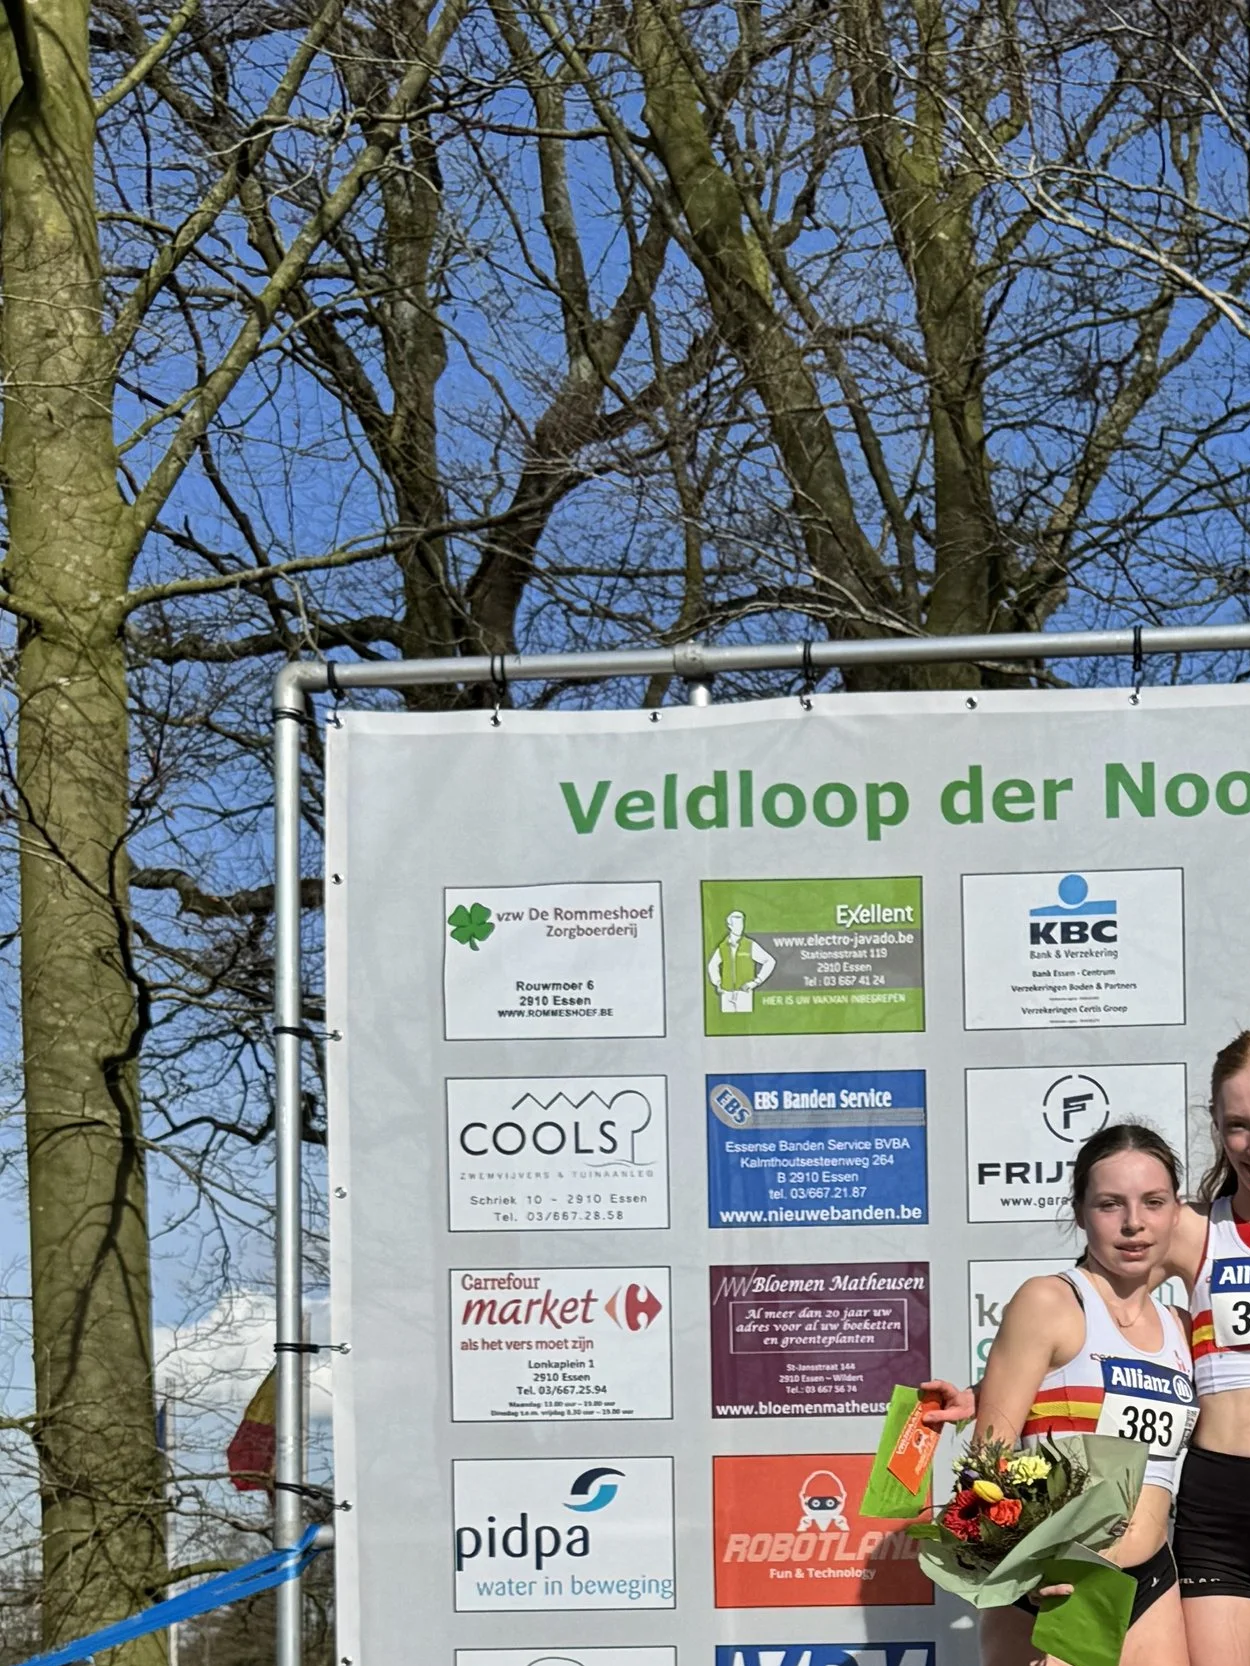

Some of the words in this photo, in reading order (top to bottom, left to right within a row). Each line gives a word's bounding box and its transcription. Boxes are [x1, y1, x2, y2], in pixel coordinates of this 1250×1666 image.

[559, 769, 910, 841] Veldloop
[940, 764, 1074, 825] der
[496, 911, 524, 922] vzw
[528, 908, 549, 921] De
[554, 905, 654, 920] Rommeshoef
[836, 904, 914, 927] Exellent
[546, 924, 638, 939] Zorgboerderij
[1029, 920, 1118, 945] KBC
[773, 933, 914, 948] www.electro-javado.be
[1029, 950, 1052, 960] Bank
[1054, 950, 1061, 959] &
[1064, 949, 1118, 960] Verzekering
[816, 963, 840, 972] 2910
[843, 963, 872, 972] Essen
[516, 981, 582, 992] Rouwmoer
[587, 980, 594, 990] 6
[519, 996, 549, 1006] 2910
[553, 996, 591, 1006] Essen
[716, 1089, 750, 1124] EBS
[754, 1091, 778, 1110] EBS
[783, 1090, 836, 1109] Banden
[840, 1088, 892, 1108] Service
[460, 1120, 618, 1156] COOLS
[725, 1141, 775, 1153] Essense
[779, 1140, 824, 1151] Banden
[828, 1139, 872, 1150] Service
[874, 1138, 910, 1149] BVBA
[740, 1156, 870, 1168] Kalmthoutsesteenweg
[872, 1155, 894, 1166] 264
[777, 1173, 786, 1183] B
[790, 1172, 819, 1182] 2910
[822, 1172, 859, 1182] Essen
[470, 1196, 517, 1205] Schriek
[527, 1195, 542, 1204] 10
[568, 1194, 602, 1204] 2910
[610, 1194, 647, 1204] Essen
[769, 1189, 787, 1200] tel.
[790, 1187, 866, 1199] 03/667.21.87
[720, 1204, 922, 1223] www.nieuwebanden.be
[461, 1272, 541, 1291] Carrefour
[752, 1274, 825, 1292] Bloemen
[829, 1273, 925, 1291] Matheusen
[462, 1288, 599, 1329] market
[461, 1339, 479, 1351] als
[481, 1338, 503, 1350] het
[506, 1340, 533, 1350] vers
[536, 1338, 569, 1349] moet
[763, 1337, 778, 1345] en
[781, 1332, 875, 1348] groenteplanten
[533, 1374, 559, 1382] 2910
[562, 1373, 591, 1381] Essen
[1111, 1366, 1172, 1394] Allianz
[517, 1387, 536, 1395] Tel.
[1119, 1406, 1173, 1447] 383
[456, 1512, 590, 1571] pidpa
[770, 1568, 793, 1579] Fun
[795, 1568, 804, 1578] &
[807, 1568, 876, 1580] Technology
[477, 1579, 537, 1596] water
[545, 1577, 563, 1595] in
[571, 1575, 674, 1600] beweging
